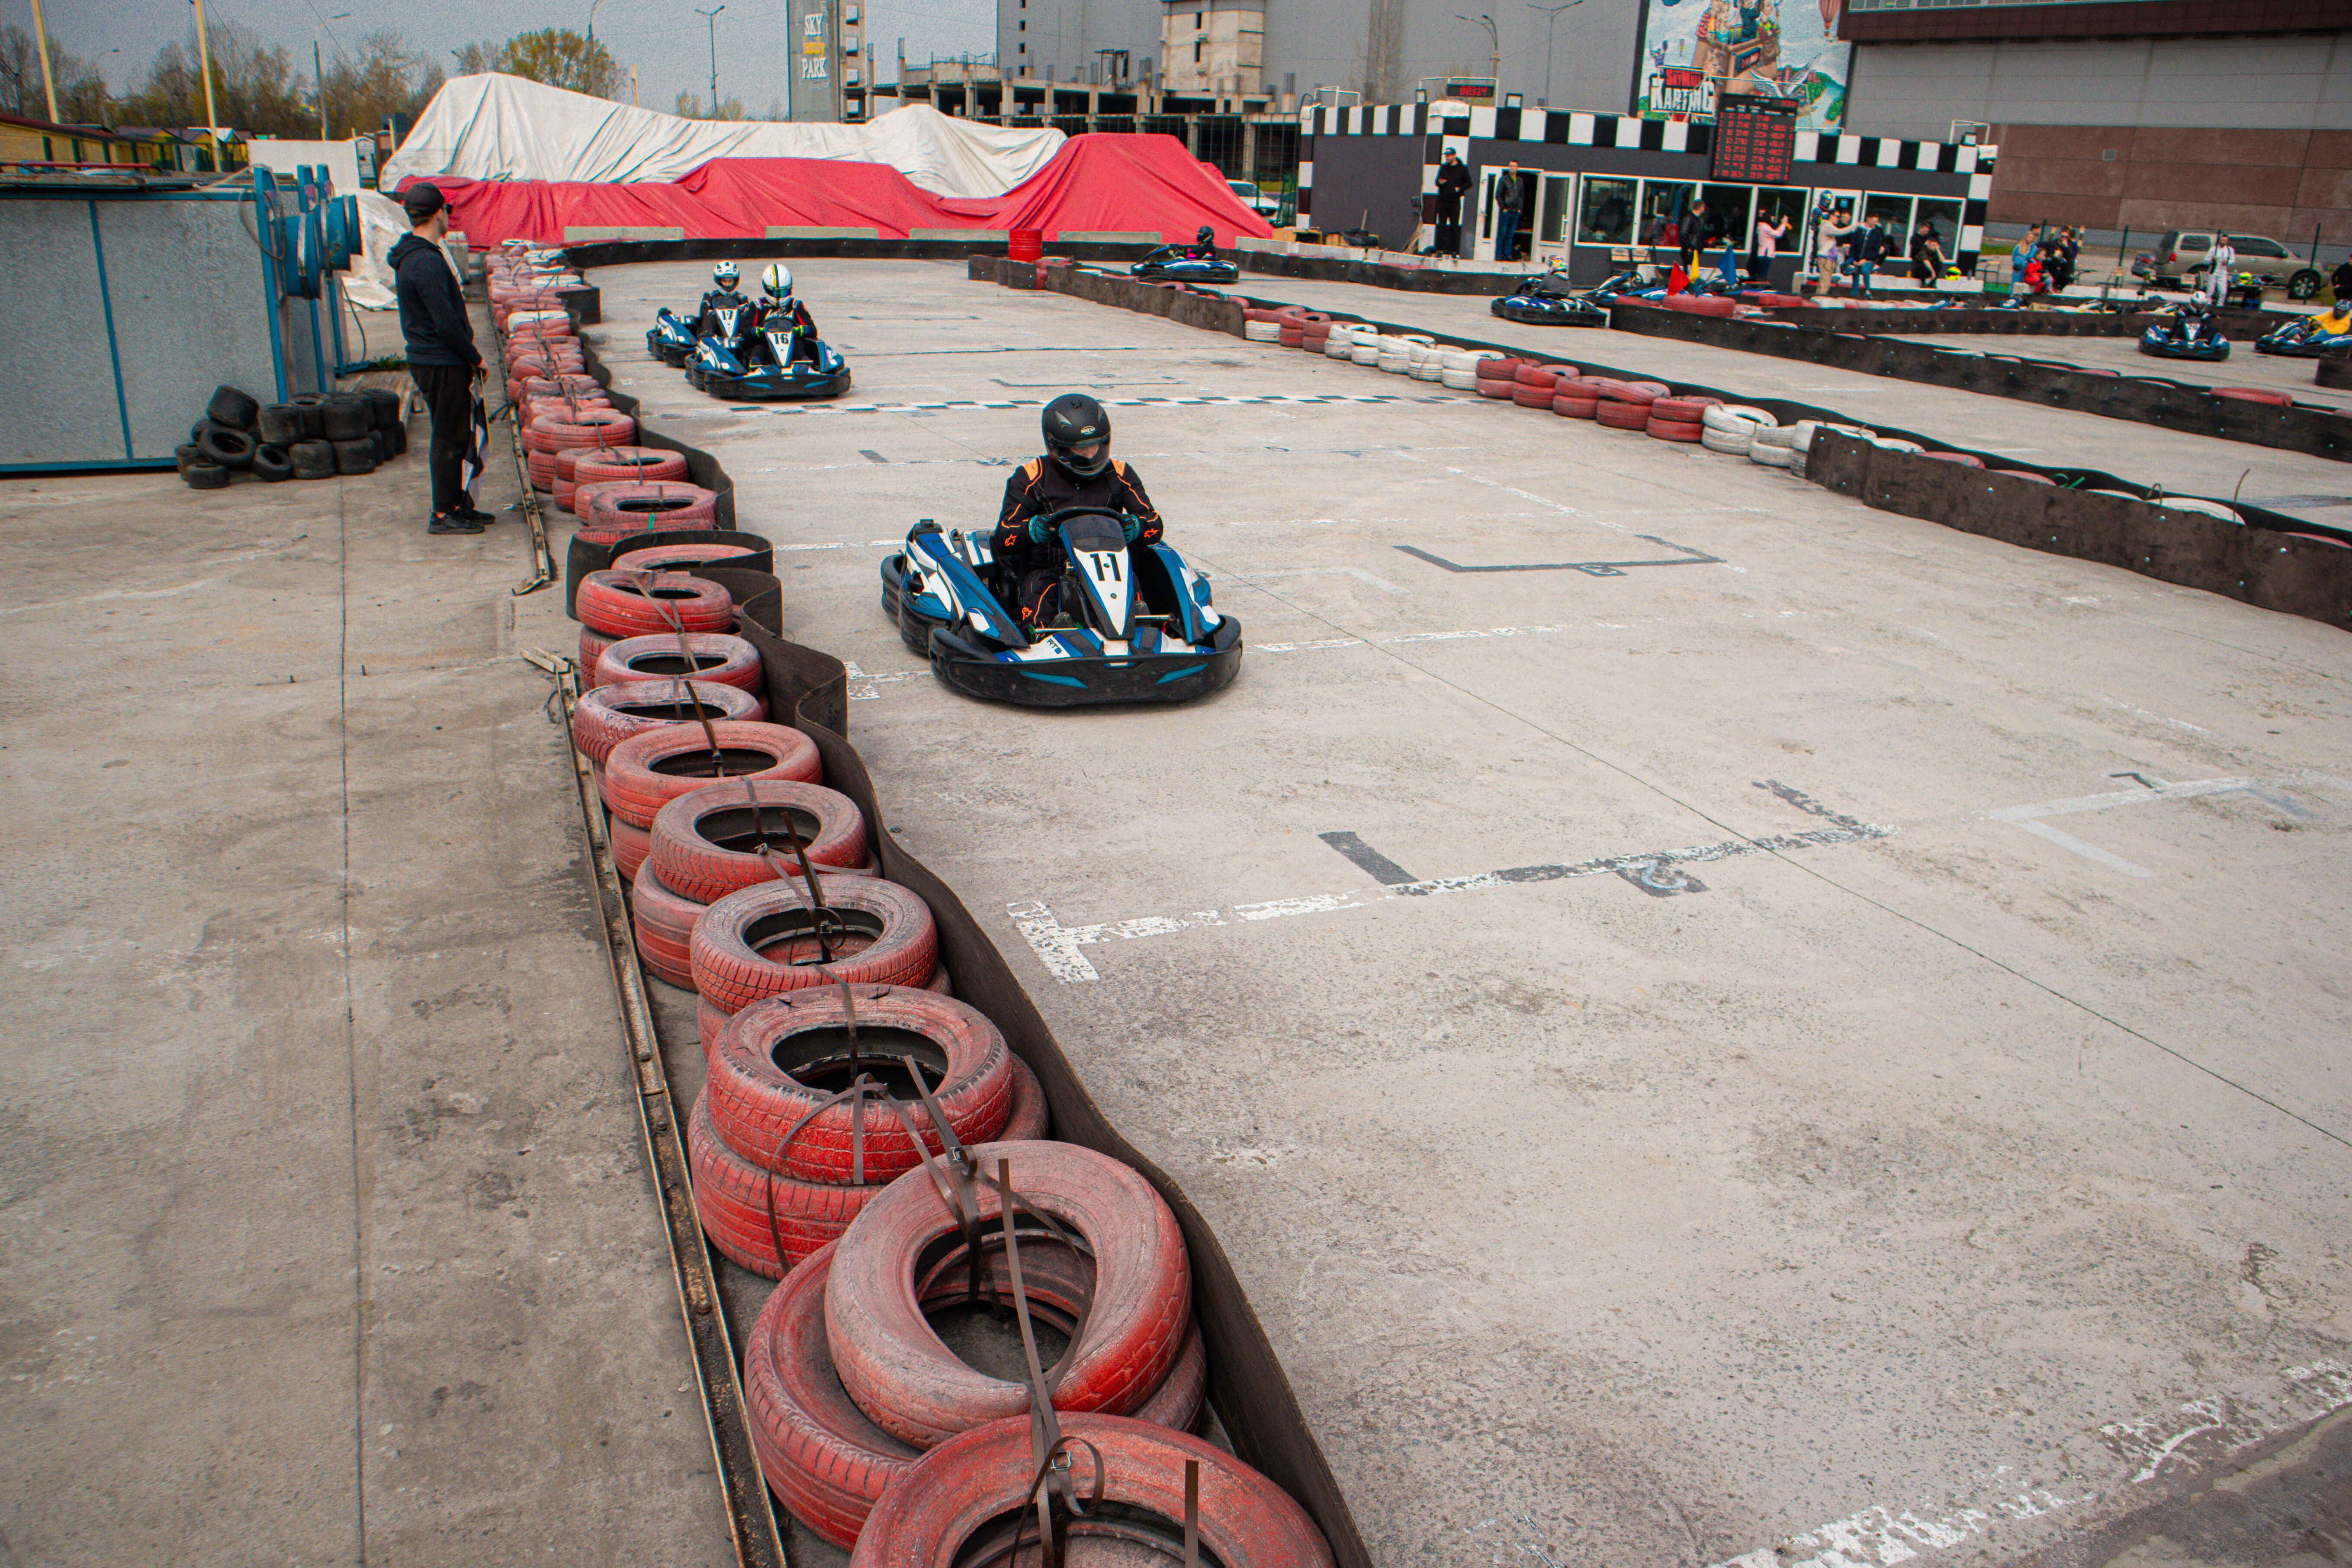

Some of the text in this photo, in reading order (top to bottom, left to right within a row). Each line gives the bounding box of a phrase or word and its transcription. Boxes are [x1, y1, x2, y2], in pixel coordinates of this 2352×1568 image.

[804, 13, 823, 36] SKY
[802, 57, 827, 79] PARK
[1650, 77, 1715, 112] KARTING
[721, 310, 733, 320] 17
[774, 333, 789, 344] 16
[1089, 553, 1121, 582] 11
